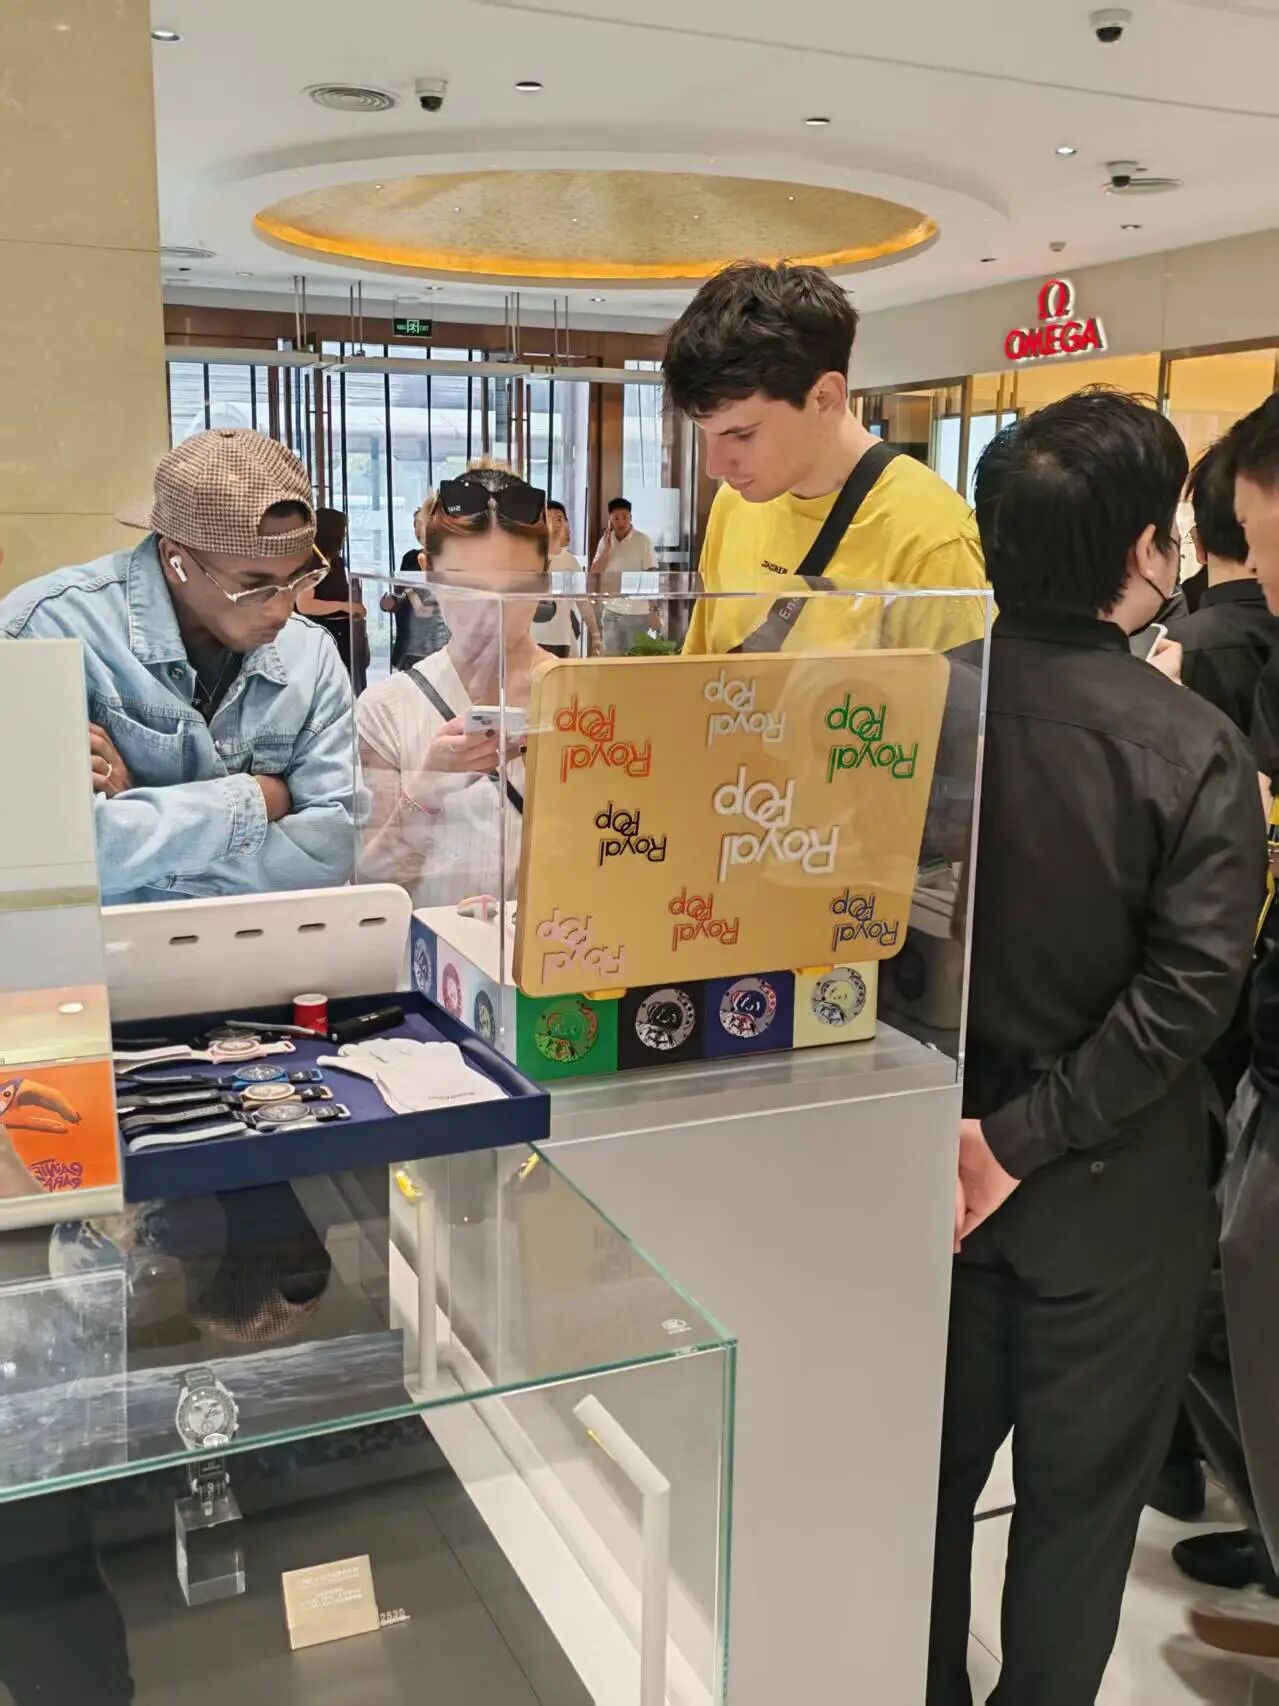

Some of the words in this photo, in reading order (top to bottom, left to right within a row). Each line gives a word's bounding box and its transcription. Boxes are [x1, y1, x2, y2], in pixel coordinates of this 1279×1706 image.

[1004, 318, 1107, 361] OMEGA
[706, 711, 786, 748] Royal
[560, 740, 652, 783] Royal
[827, 740, 918, 783] Royal
[598, 836, 667, 866] Royal
[717, 824, 840, 884] Royal
[672, 917, 739, 951] Royal
[832, 918, 899, 951] Royal
[541, 944, 626, 984] Royal
